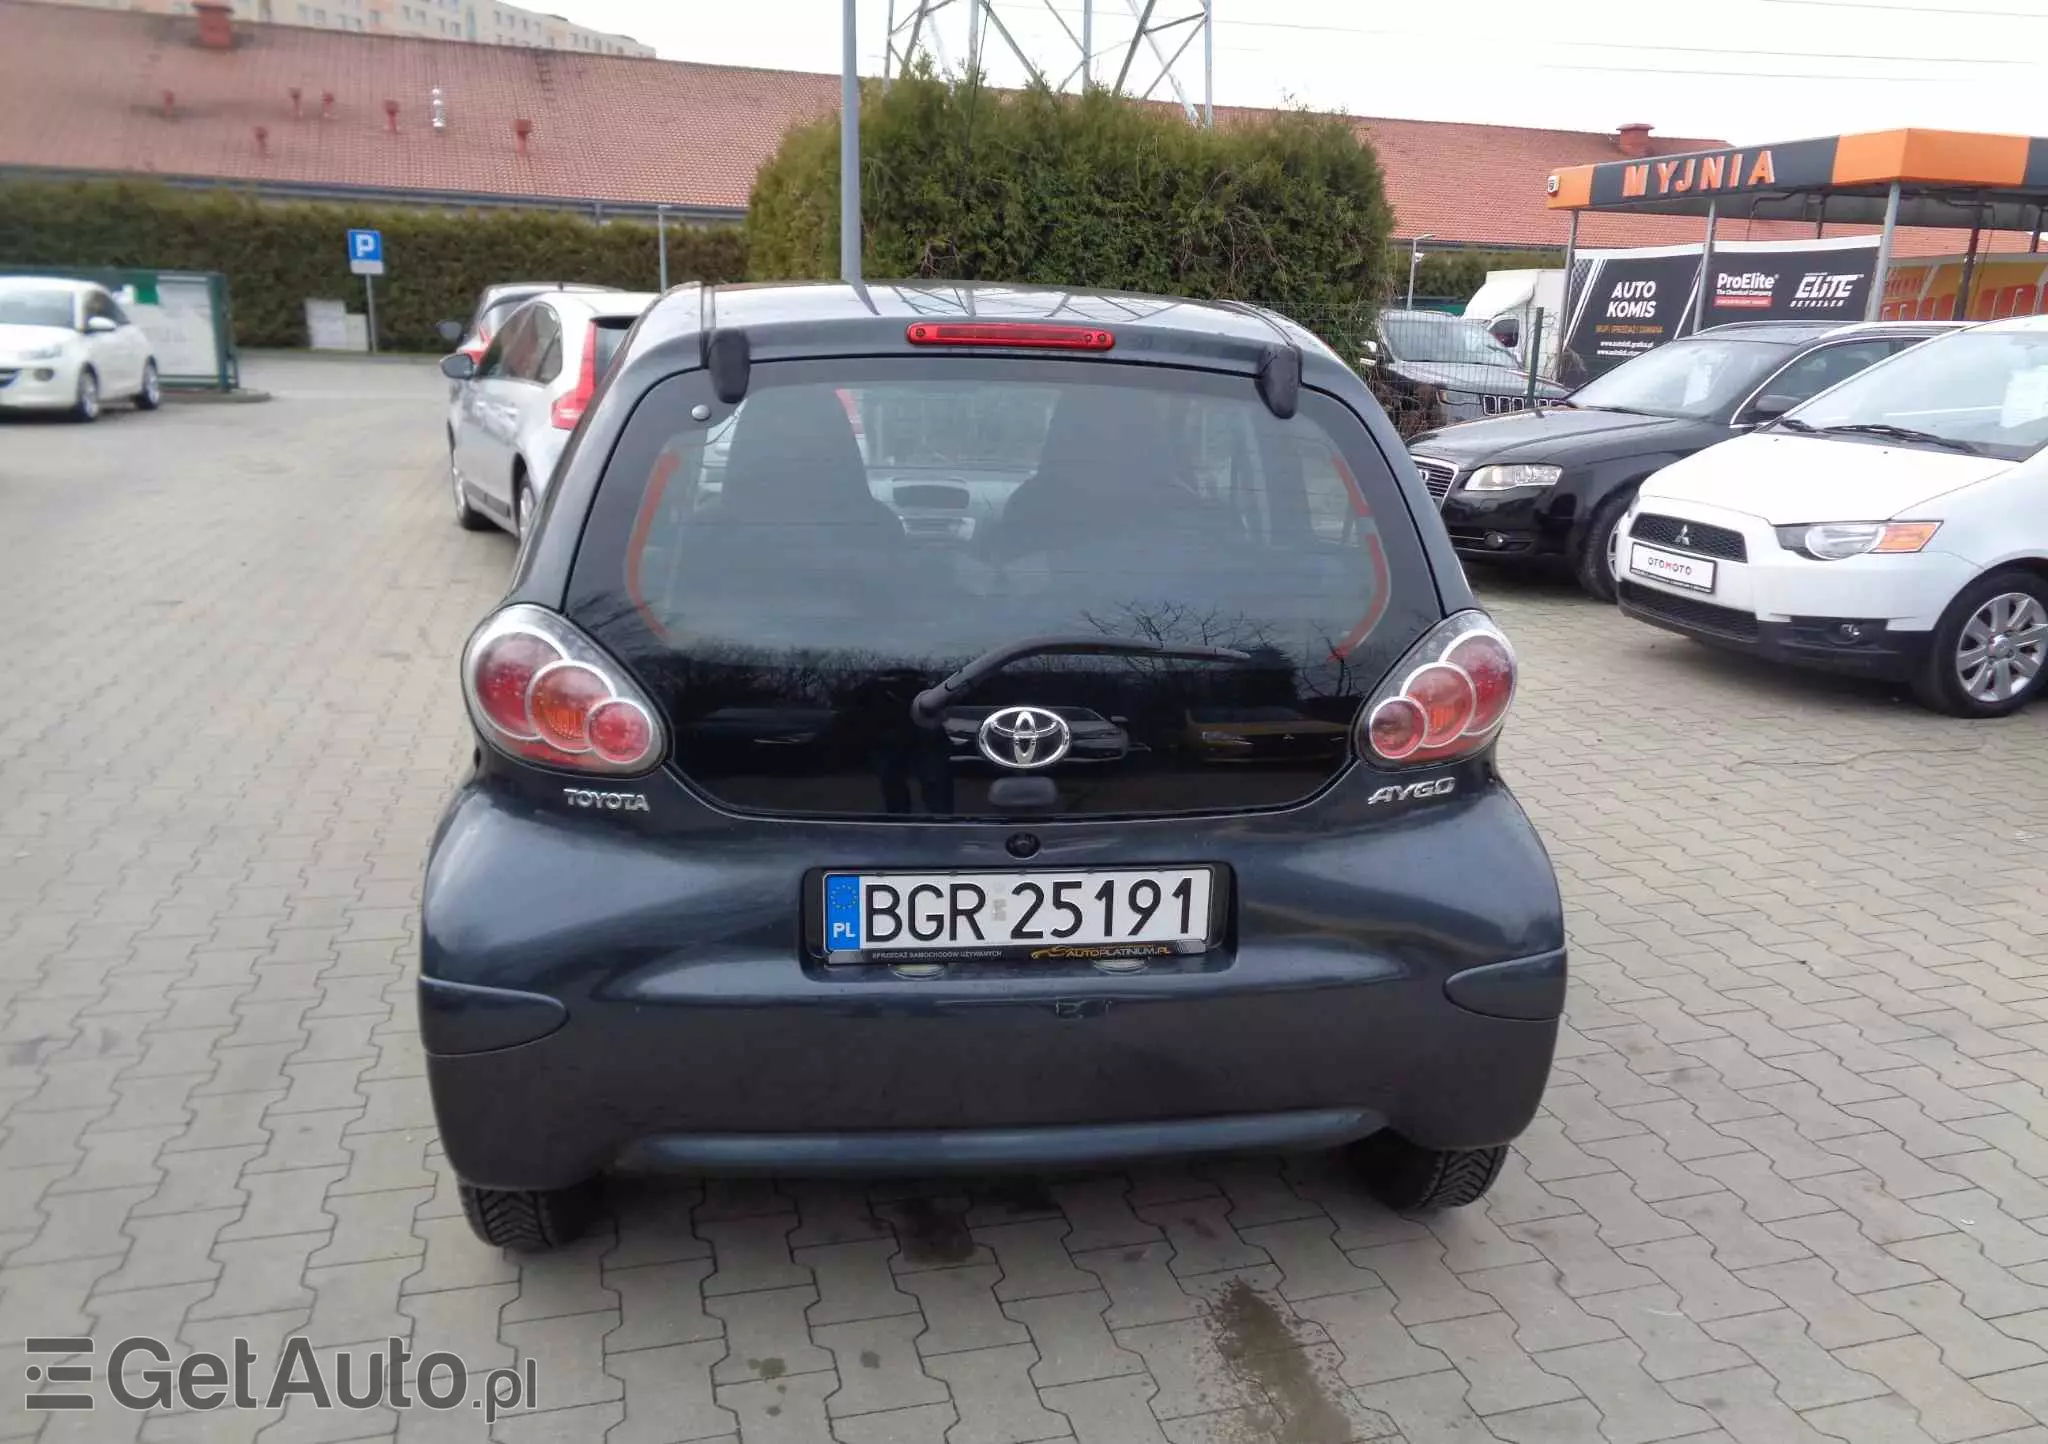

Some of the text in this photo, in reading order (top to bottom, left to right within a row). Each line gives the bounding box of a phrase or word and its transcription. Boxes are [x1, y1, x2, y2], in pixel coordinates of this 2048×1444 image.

[1623, 150, 1774, 197] MYJNIA
[356, 234, 374, 257] P
[1611, 281, 1656, 298] AUTO
[1606, 301, 1657, 318] KOMIS
[1648, 556, 1693, 576] OTOMOTO
[563, 788, 650, 812] TOYOTA
[1367, 777, 1456, 804] AYGO
[865, 877, 1193, 943] BGR 25191
[832, 922, 856, 938] PL
